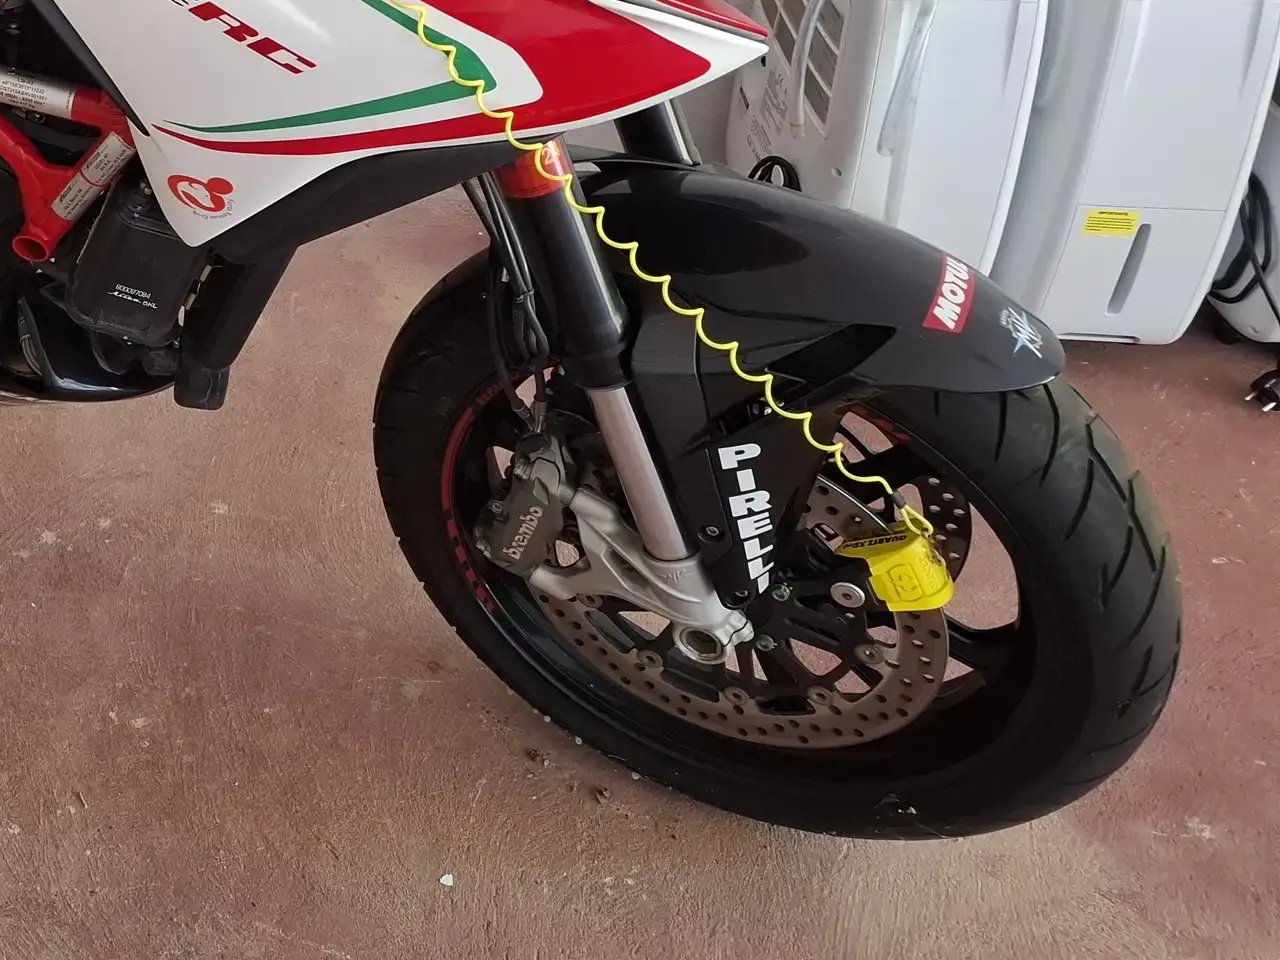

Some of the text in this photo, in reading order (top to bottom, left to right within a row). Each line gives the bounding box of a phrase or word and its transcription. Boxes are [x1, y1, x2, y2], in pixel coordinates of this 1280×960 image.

[188, 1, 317, 75] RC
[501, 505, 544, 561] brembo
[717, 443, 775, 594] PIRELLI
[868, 534, 908, 548] QUARTZ
